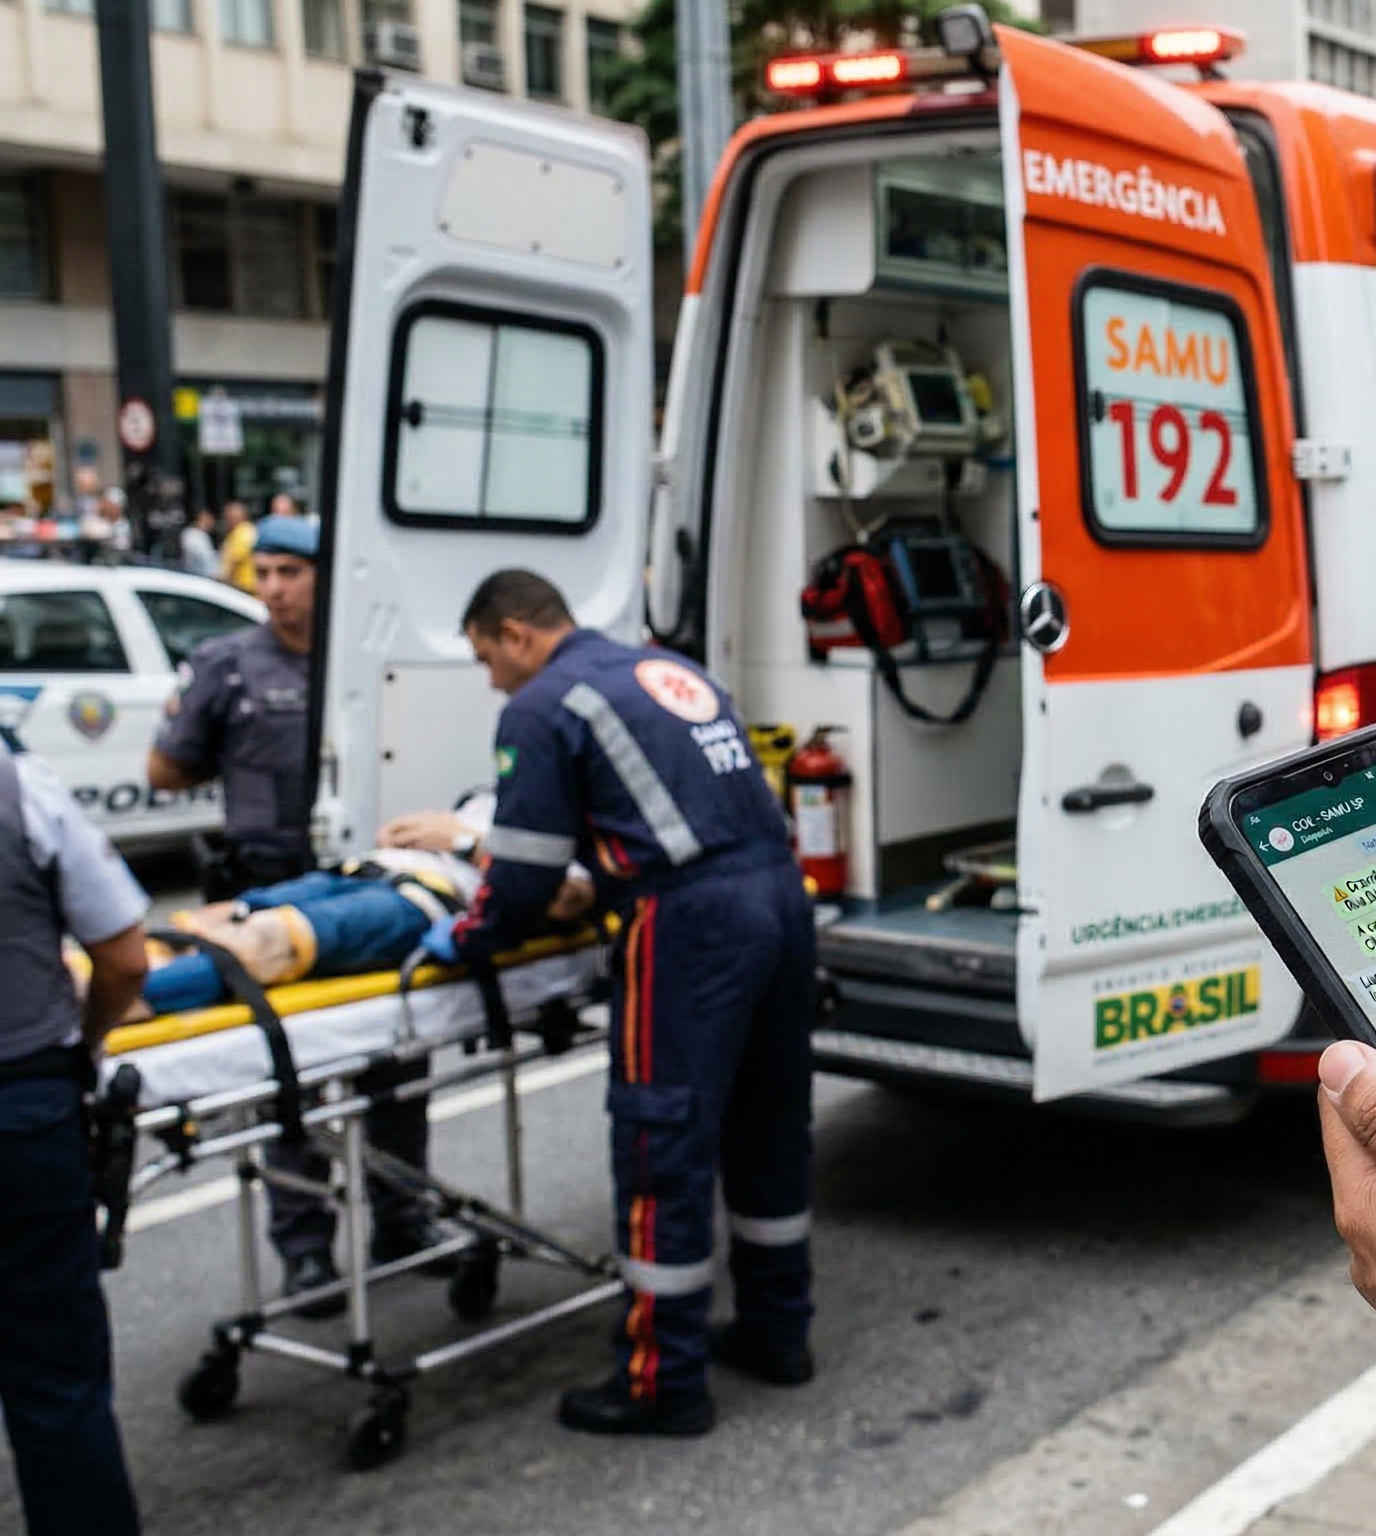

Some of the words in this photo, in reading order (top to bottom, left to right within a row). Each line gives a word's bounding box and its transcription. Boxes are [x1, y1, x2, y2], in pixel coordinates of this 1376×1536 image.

[1024, 149, 1226, 236] EMERGÊNCIA
[1106, 316, 1228, 386] SAMU
[1110, 401, 1237, 505] 192
[1095, 971, 1258, 1049] BRASIL
